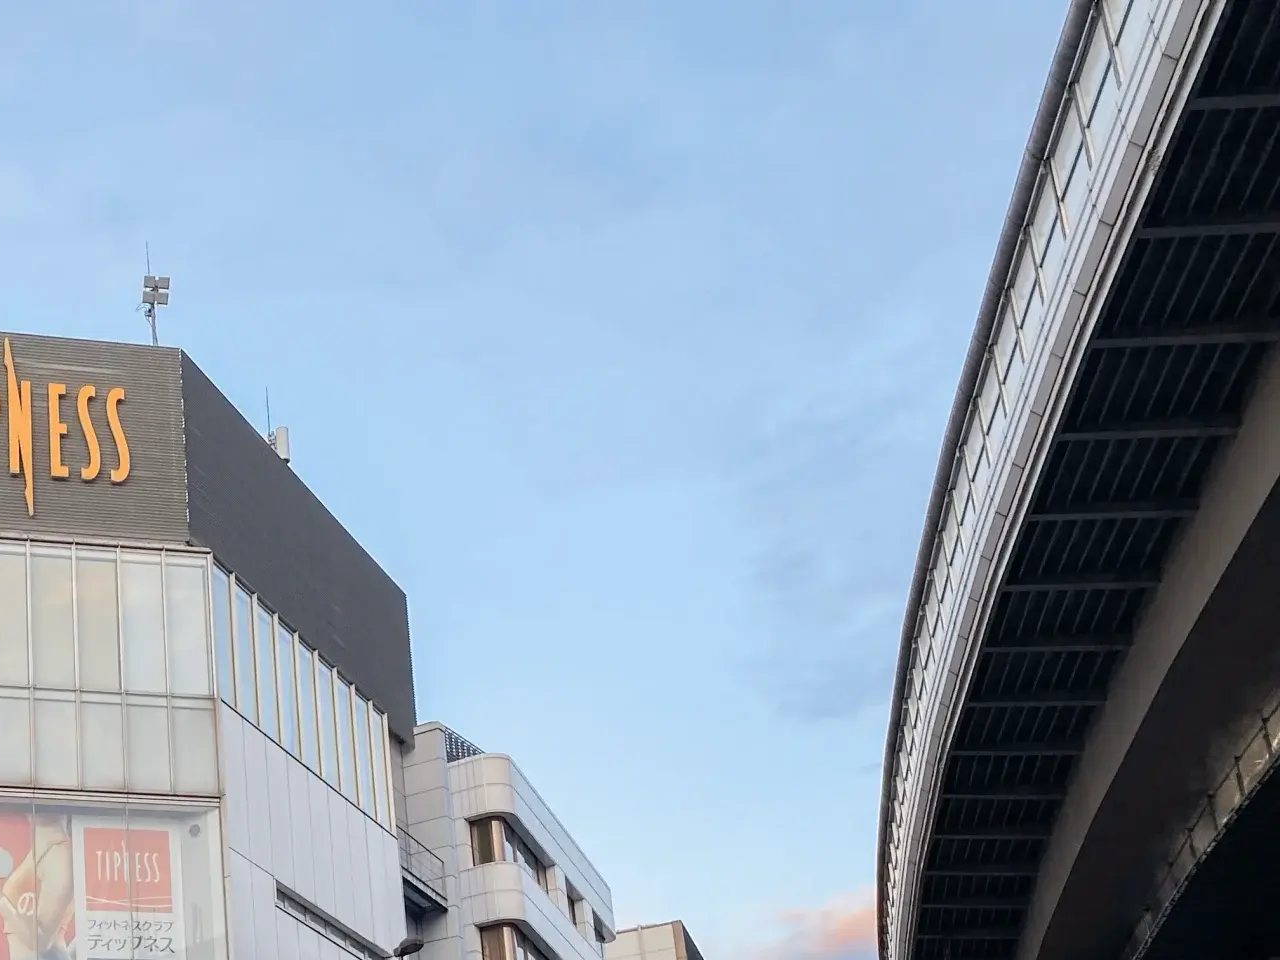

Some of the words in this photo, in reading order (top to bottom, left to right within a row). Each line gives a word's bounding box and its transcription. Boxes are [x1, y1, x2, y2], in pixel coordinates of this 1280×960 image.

[88, 920, 174, 932] フィットネスクラブ
[88, 935, 176, 953] ティップネス
